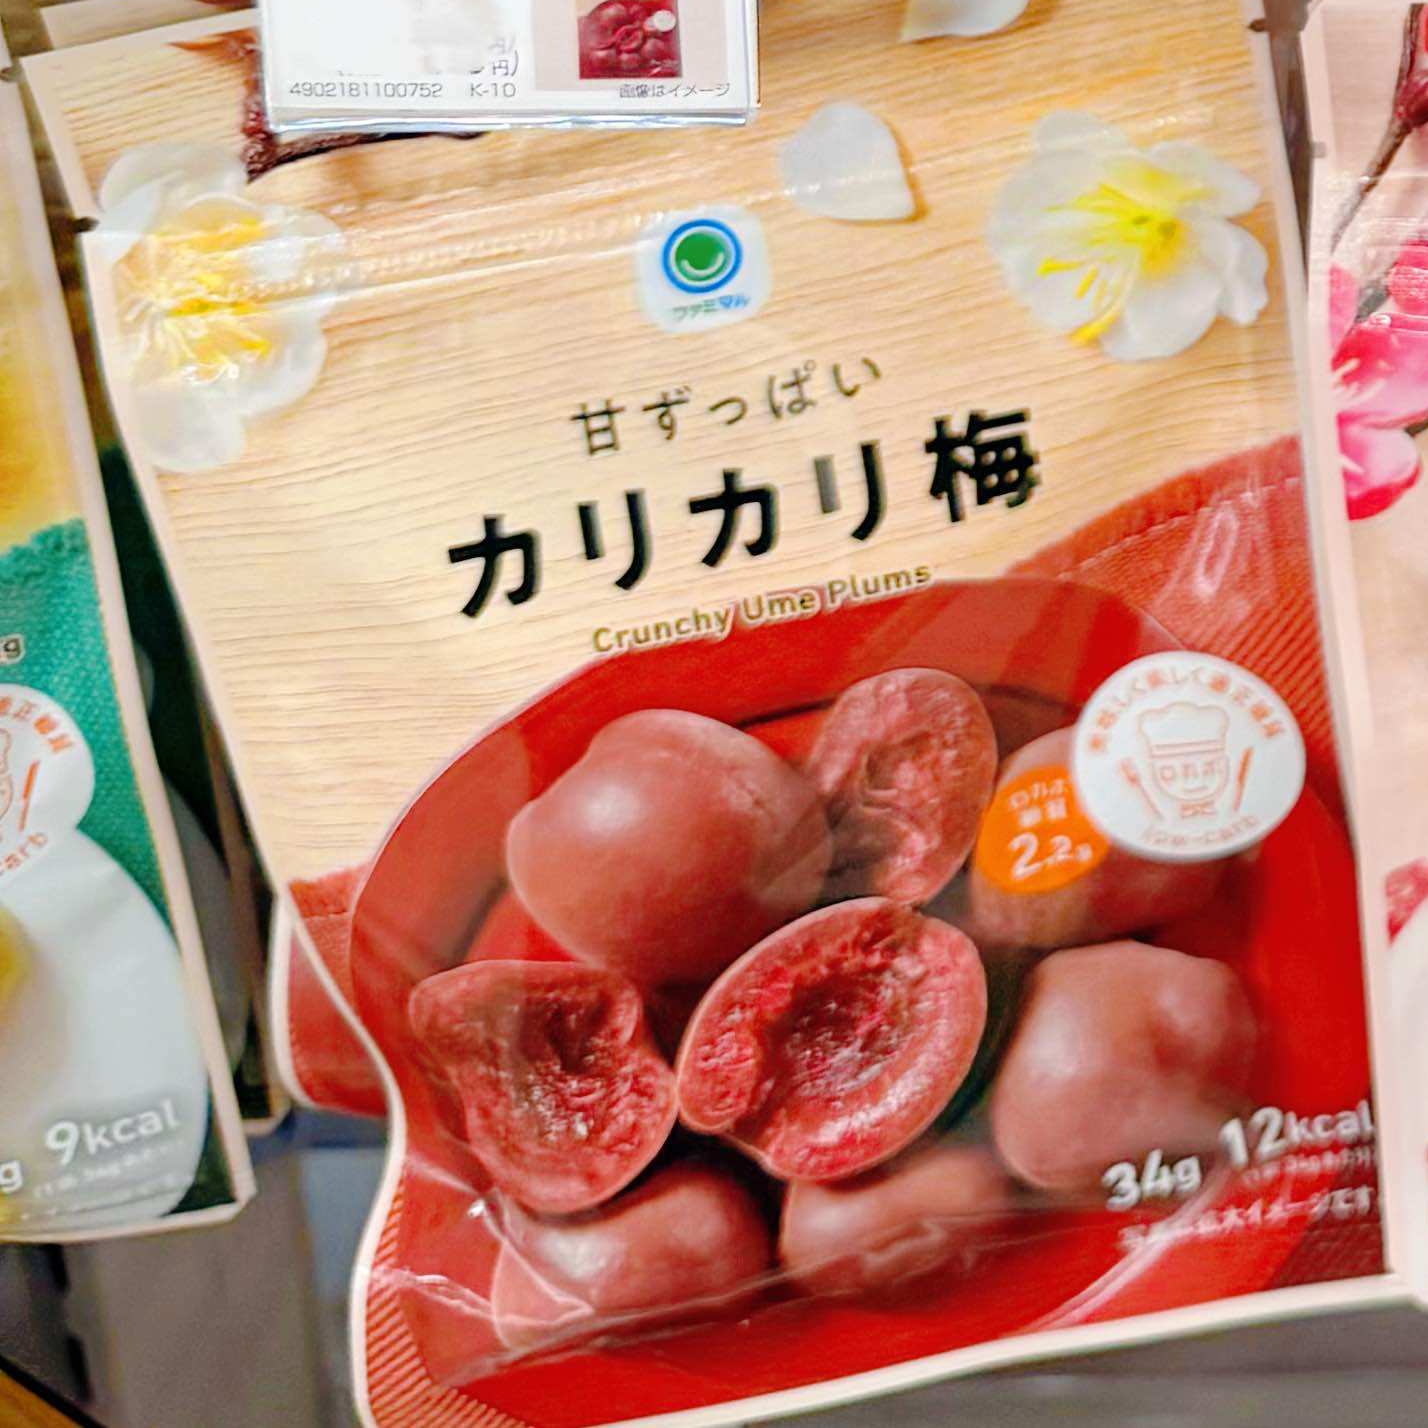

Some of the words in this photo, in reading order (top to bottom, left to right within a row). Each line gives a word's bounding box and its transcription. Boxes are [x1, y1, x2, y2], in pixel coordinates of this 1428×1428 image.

[288, 82, 444, 98] 4902181100752
[470, 82, 517, 98] K-10
[570, 353, 884, 457] 甘ずっぱい
[446, 406, 1043, 619] カリカリ梅
[593, 604, 731, 655] Crunchy
[744, 588, 817, 623] Ume
[825, 561, 934, 608] Plums
[45, 1097, 181, 1167] 9kcal
[1100, 1148, 1202, 1212] 34g
[1219, 1099, 1374, 1169] 12kcal
